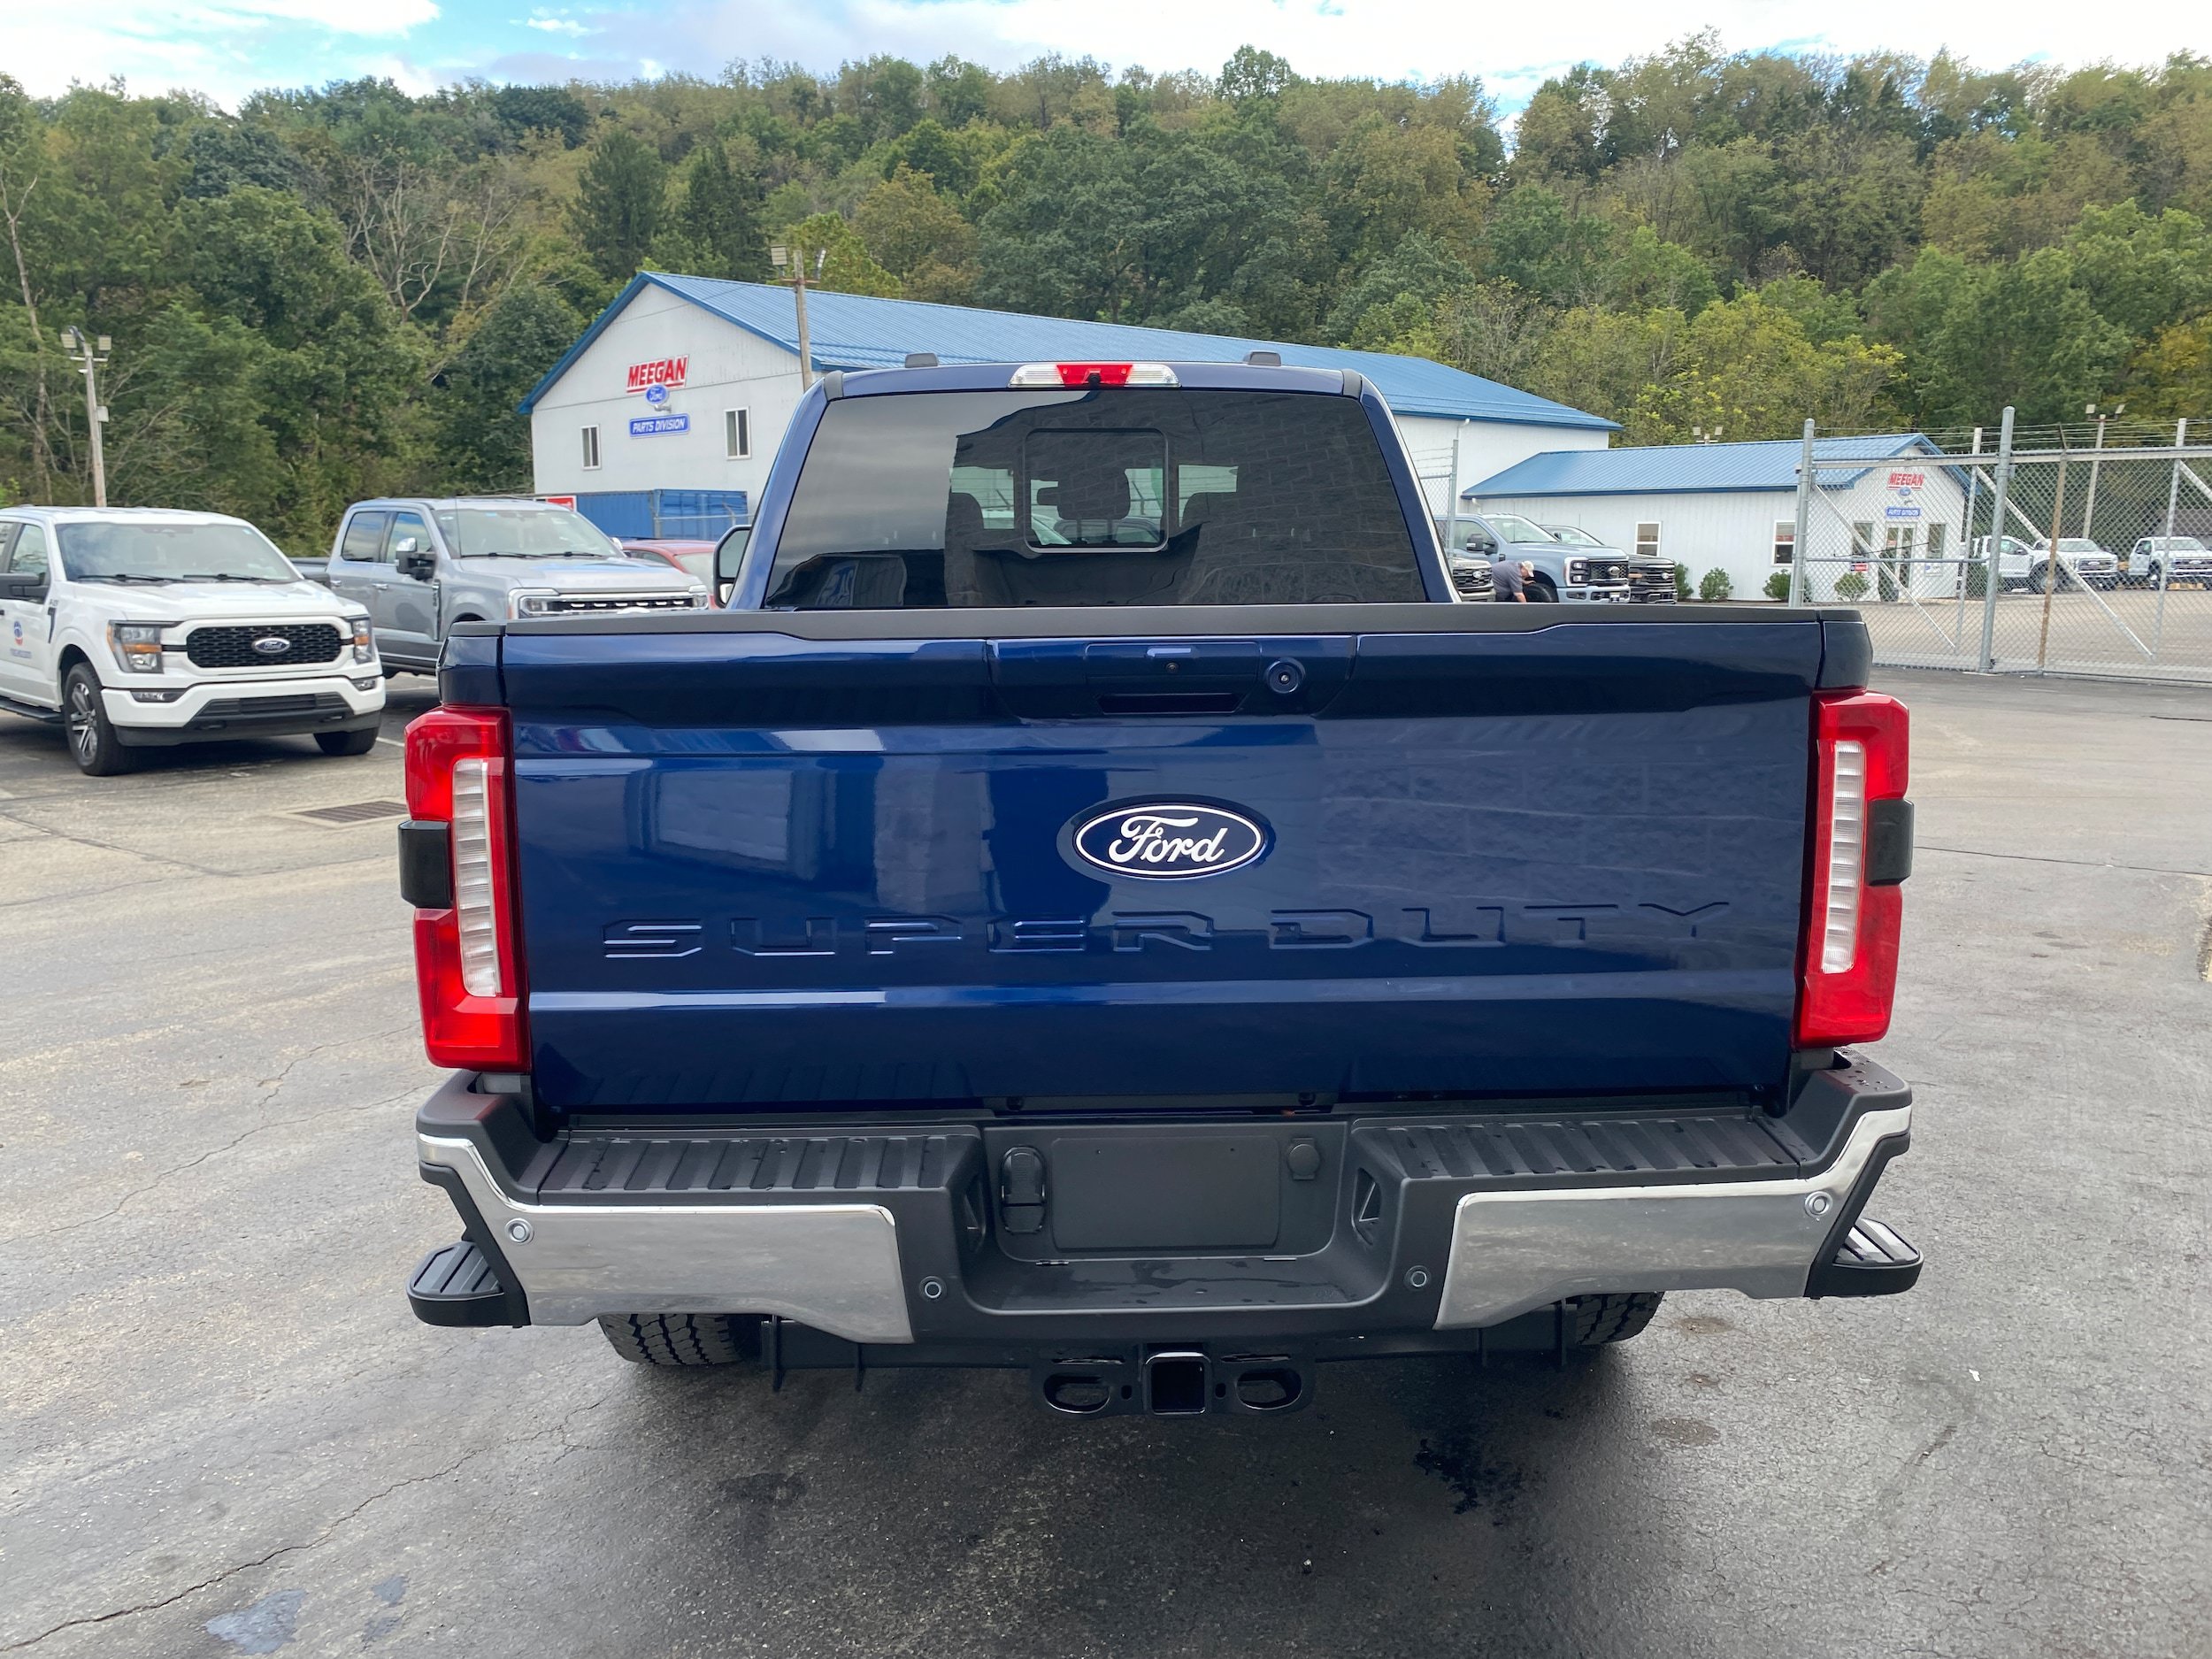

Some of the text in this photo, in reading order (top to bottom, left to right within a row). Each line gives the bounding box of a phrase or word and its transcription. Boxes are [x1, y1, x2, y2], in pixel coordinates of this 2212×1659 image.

[627, 357, 687, 387] MEEGAN
[633, 418, 686, 434] PARTS DIVISION
[1888, 472, 1924, 486] MEEGAN
[1109, 815, 1228, 863] Ford
[602, 901, 1731, 959] SUPER DUTY
